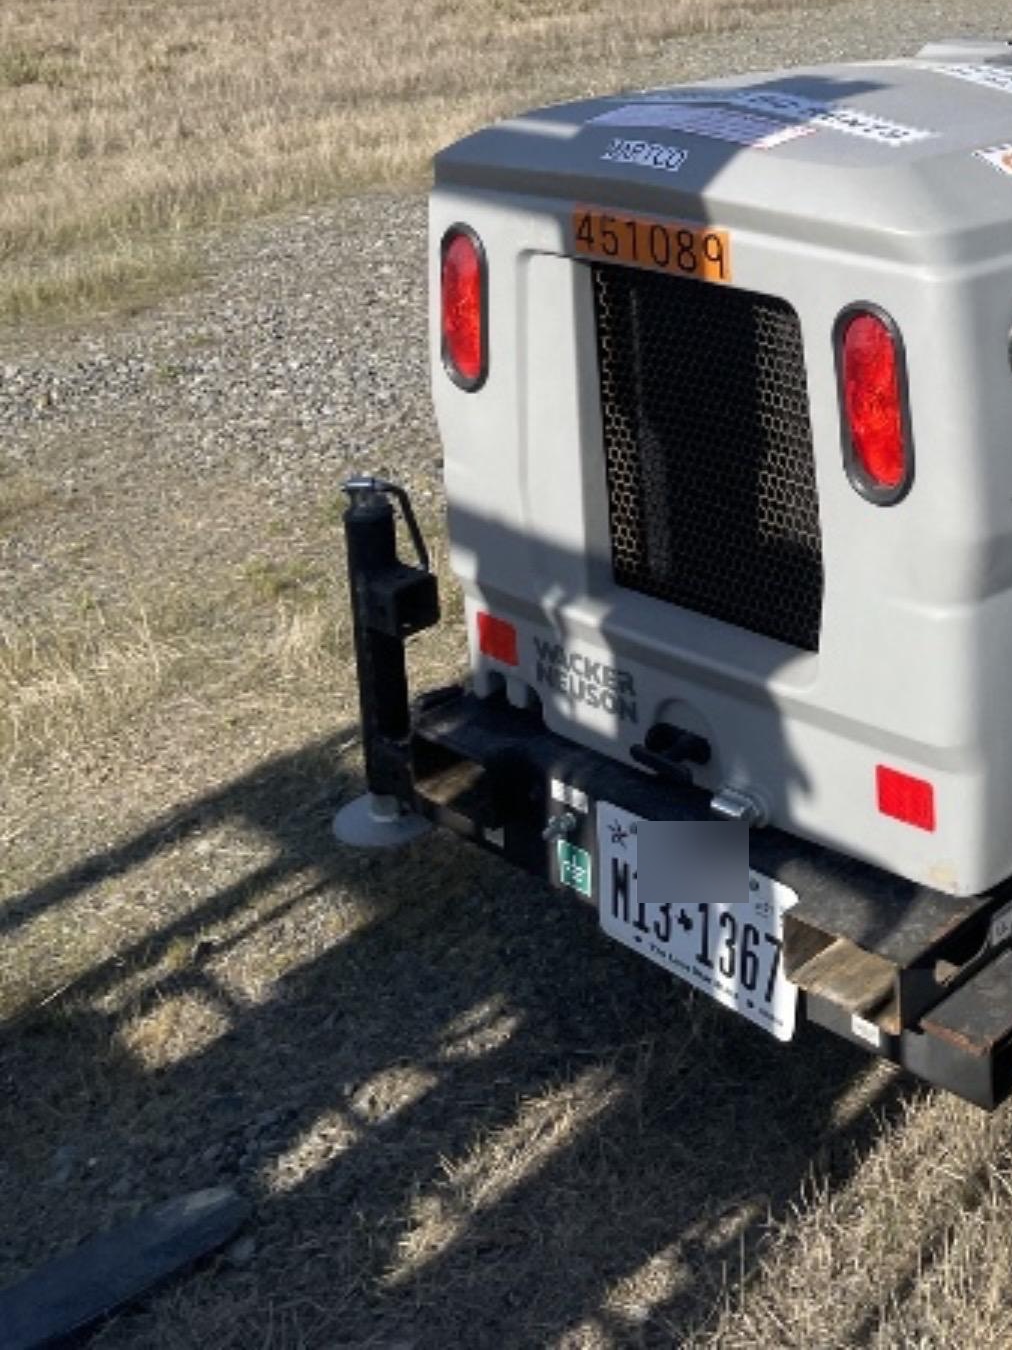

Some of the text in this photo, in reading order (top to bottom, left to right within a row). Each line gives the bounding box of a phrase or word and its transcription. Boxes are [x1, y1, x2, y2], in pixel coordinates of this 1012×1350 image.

[575, 213, 726, 281] 451089
[534, 636, 637, 697] WACKER
[537, 663, 638, 724] NEUSON
